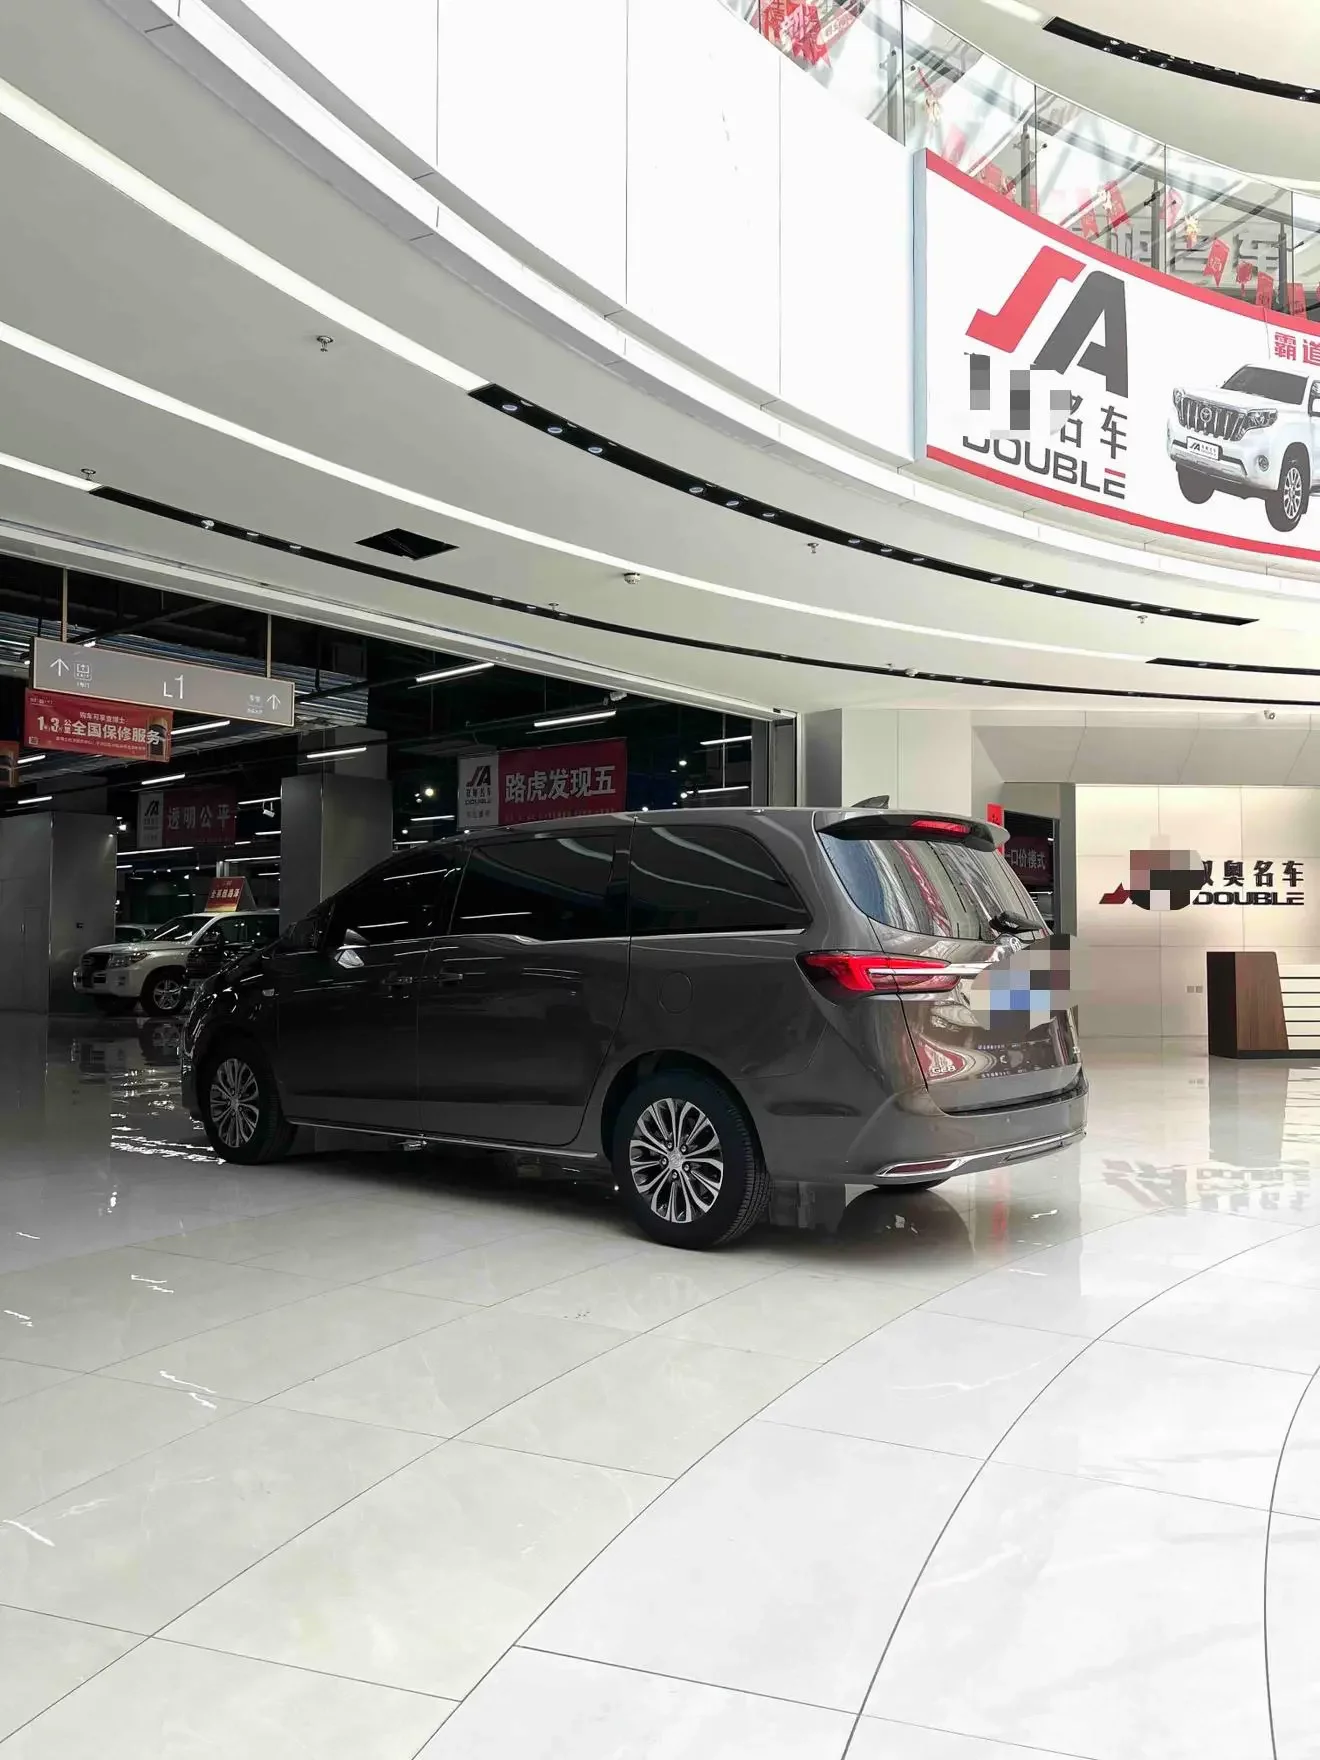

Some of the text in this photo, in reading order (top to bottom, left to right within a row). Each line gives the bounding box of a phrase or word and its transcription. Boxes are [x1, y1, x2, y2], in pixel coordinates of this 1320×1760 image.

[1275, 332, 1320, 367] 霸道
[163, 675, 184, 699] L1
[505, 765, 616, 803] 路虎发现五
[167, 803, 231, 830] 透明公平
[1192, 891, 1304, 905] DOUBLE
